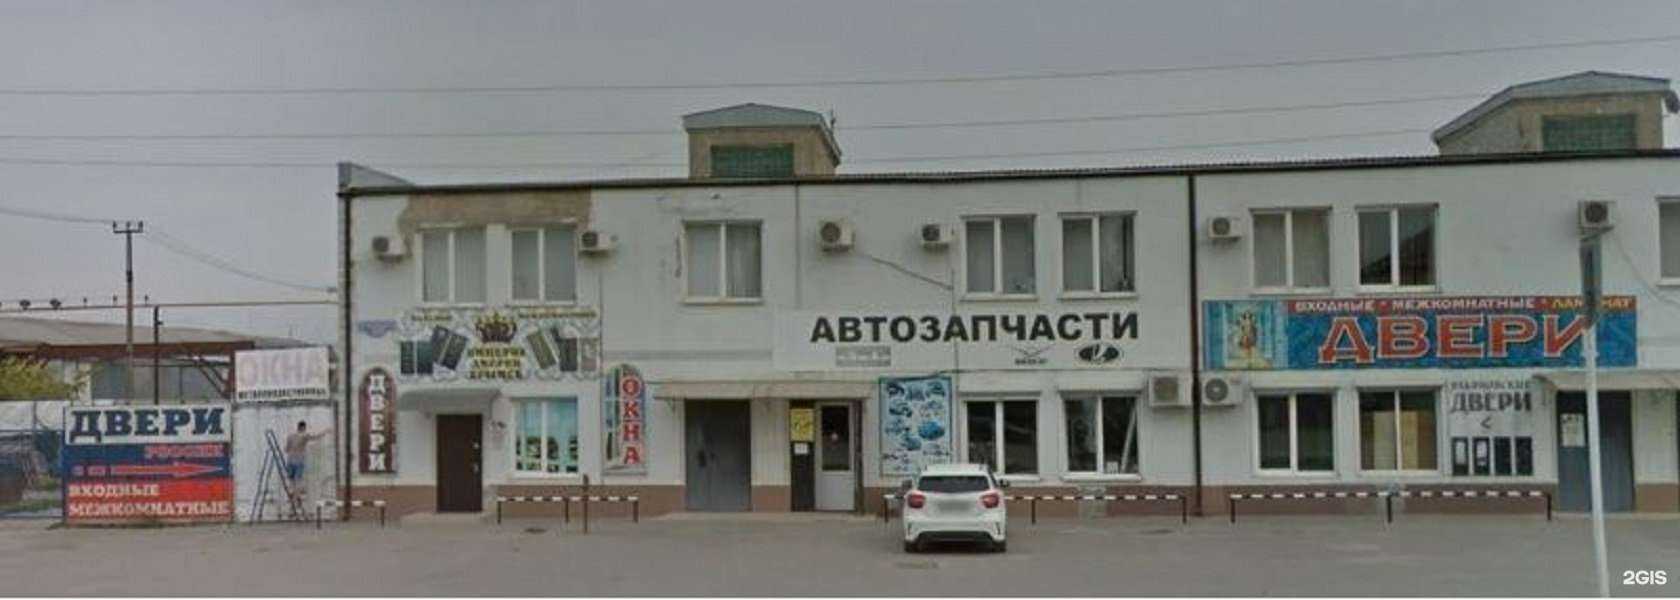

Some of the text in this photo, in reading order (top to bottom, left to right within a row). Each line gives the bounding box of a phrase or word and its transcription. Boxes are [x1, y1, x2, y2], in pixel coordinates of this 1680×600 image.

[1294, 300, 1375, 312] ВХОДНЫЕ
[1392, 298, 1536, 311] МЕЖКОМНАТНЫЕ
[810, 311, 1140, 343] АВТОЗАПЧАСТИ
[1317, 315, 1597, 364] ДВЕРИ
[238, 352, 327, 386] ОКНА
[1450, 391, 1532, 415] ДВЕРИ
[70, 407, 225, 443] ДВЕРИ
[368, 374, 388, 472] ДВЕРИ
[622, 376, 642, 465] ОКНА
[68, 483, 160, 498] ВХОДНЫЕ
[68, 500, 231, 516] МЕЖКОМНАТНЫЕ
